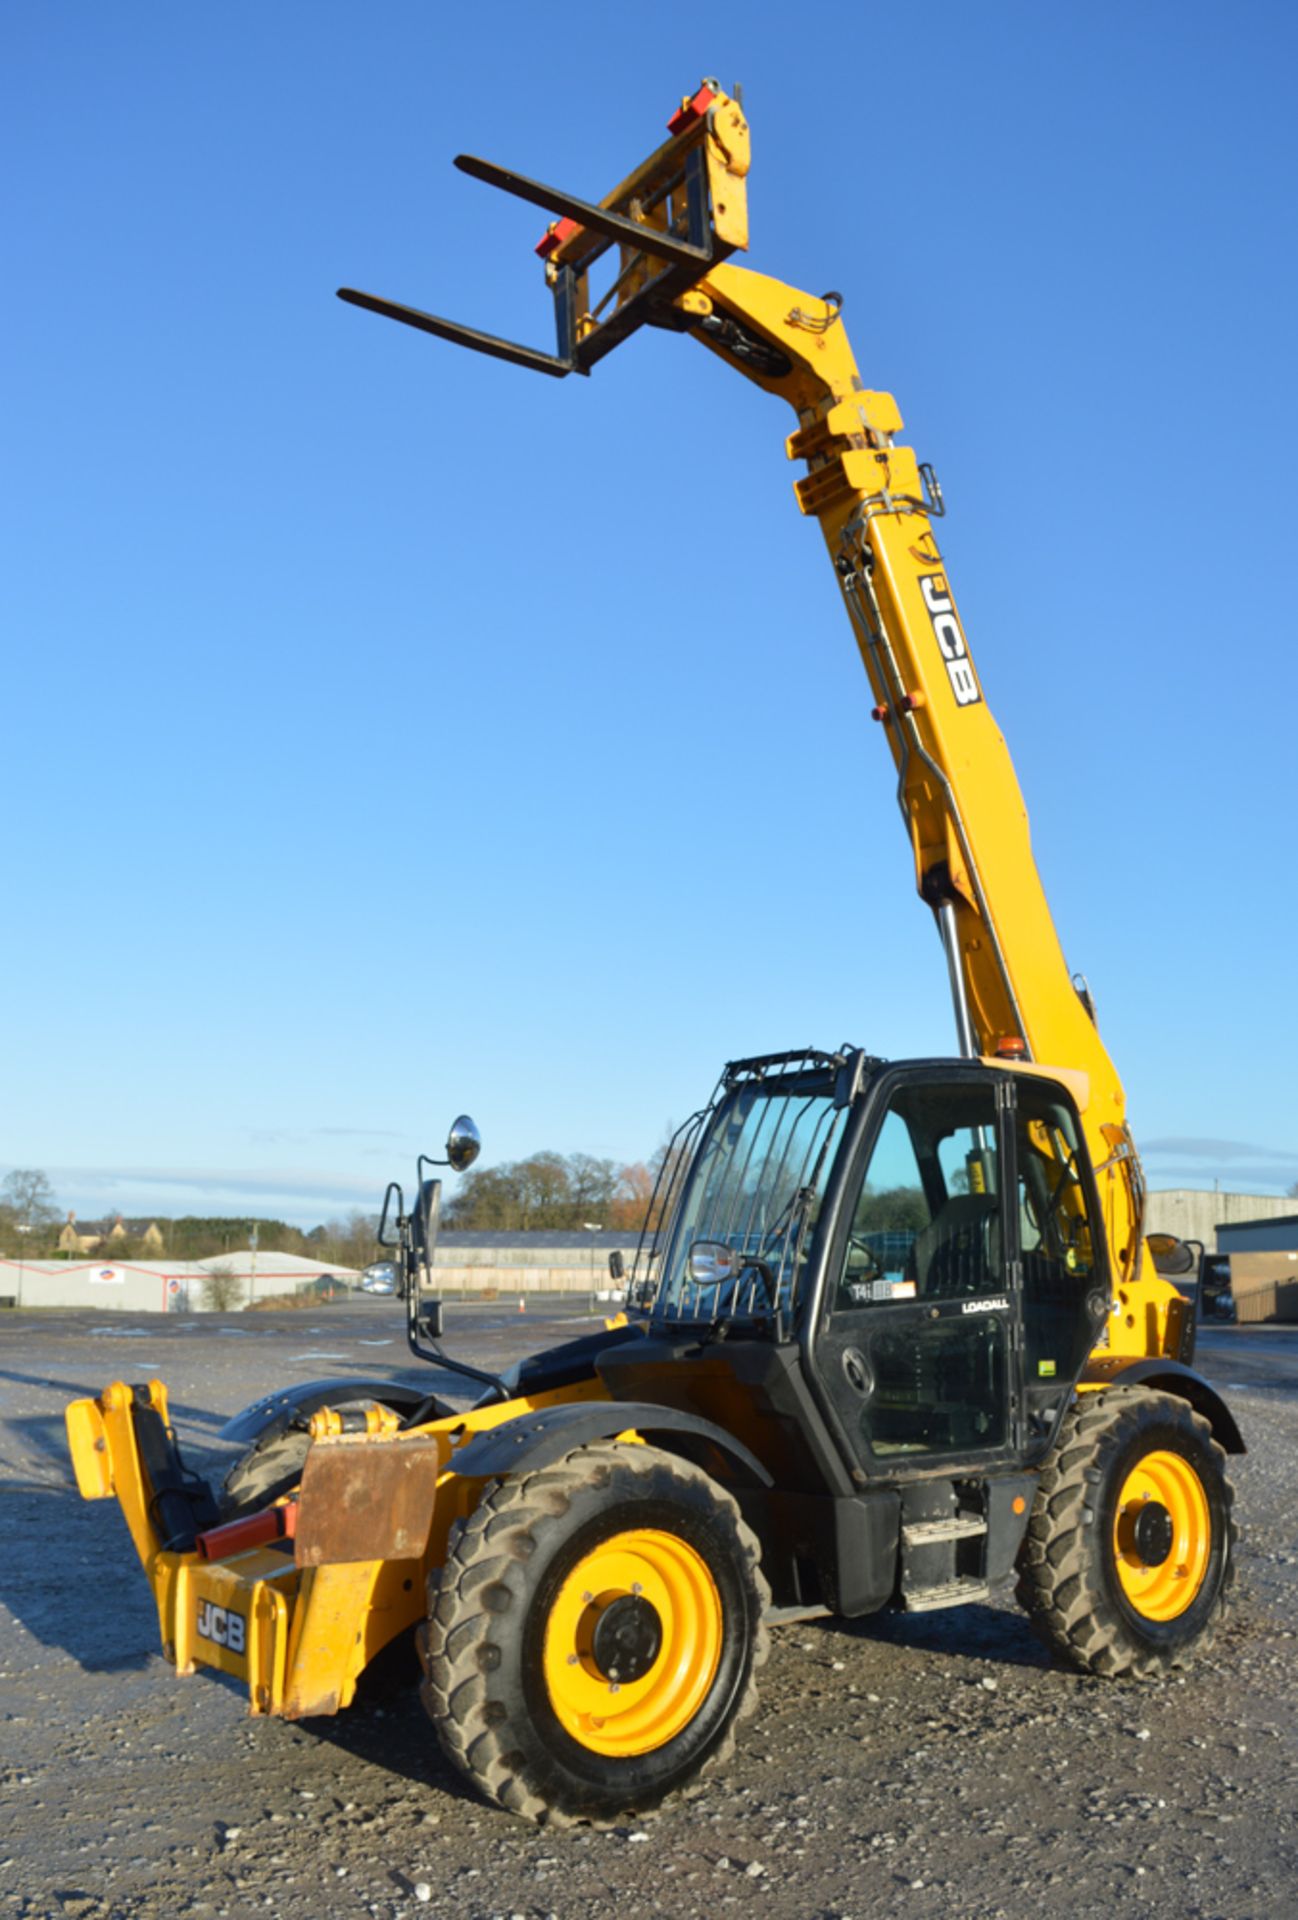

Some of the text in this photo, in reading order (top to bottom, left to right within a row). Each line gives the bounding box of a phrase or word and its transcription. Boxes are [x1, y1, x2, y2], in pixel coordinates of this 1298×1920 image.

[920, 576, 979, 704] JCB
[961, 1298, 1010, 1315] LOADALL
[198, 1602, 245, 1652] JCB
